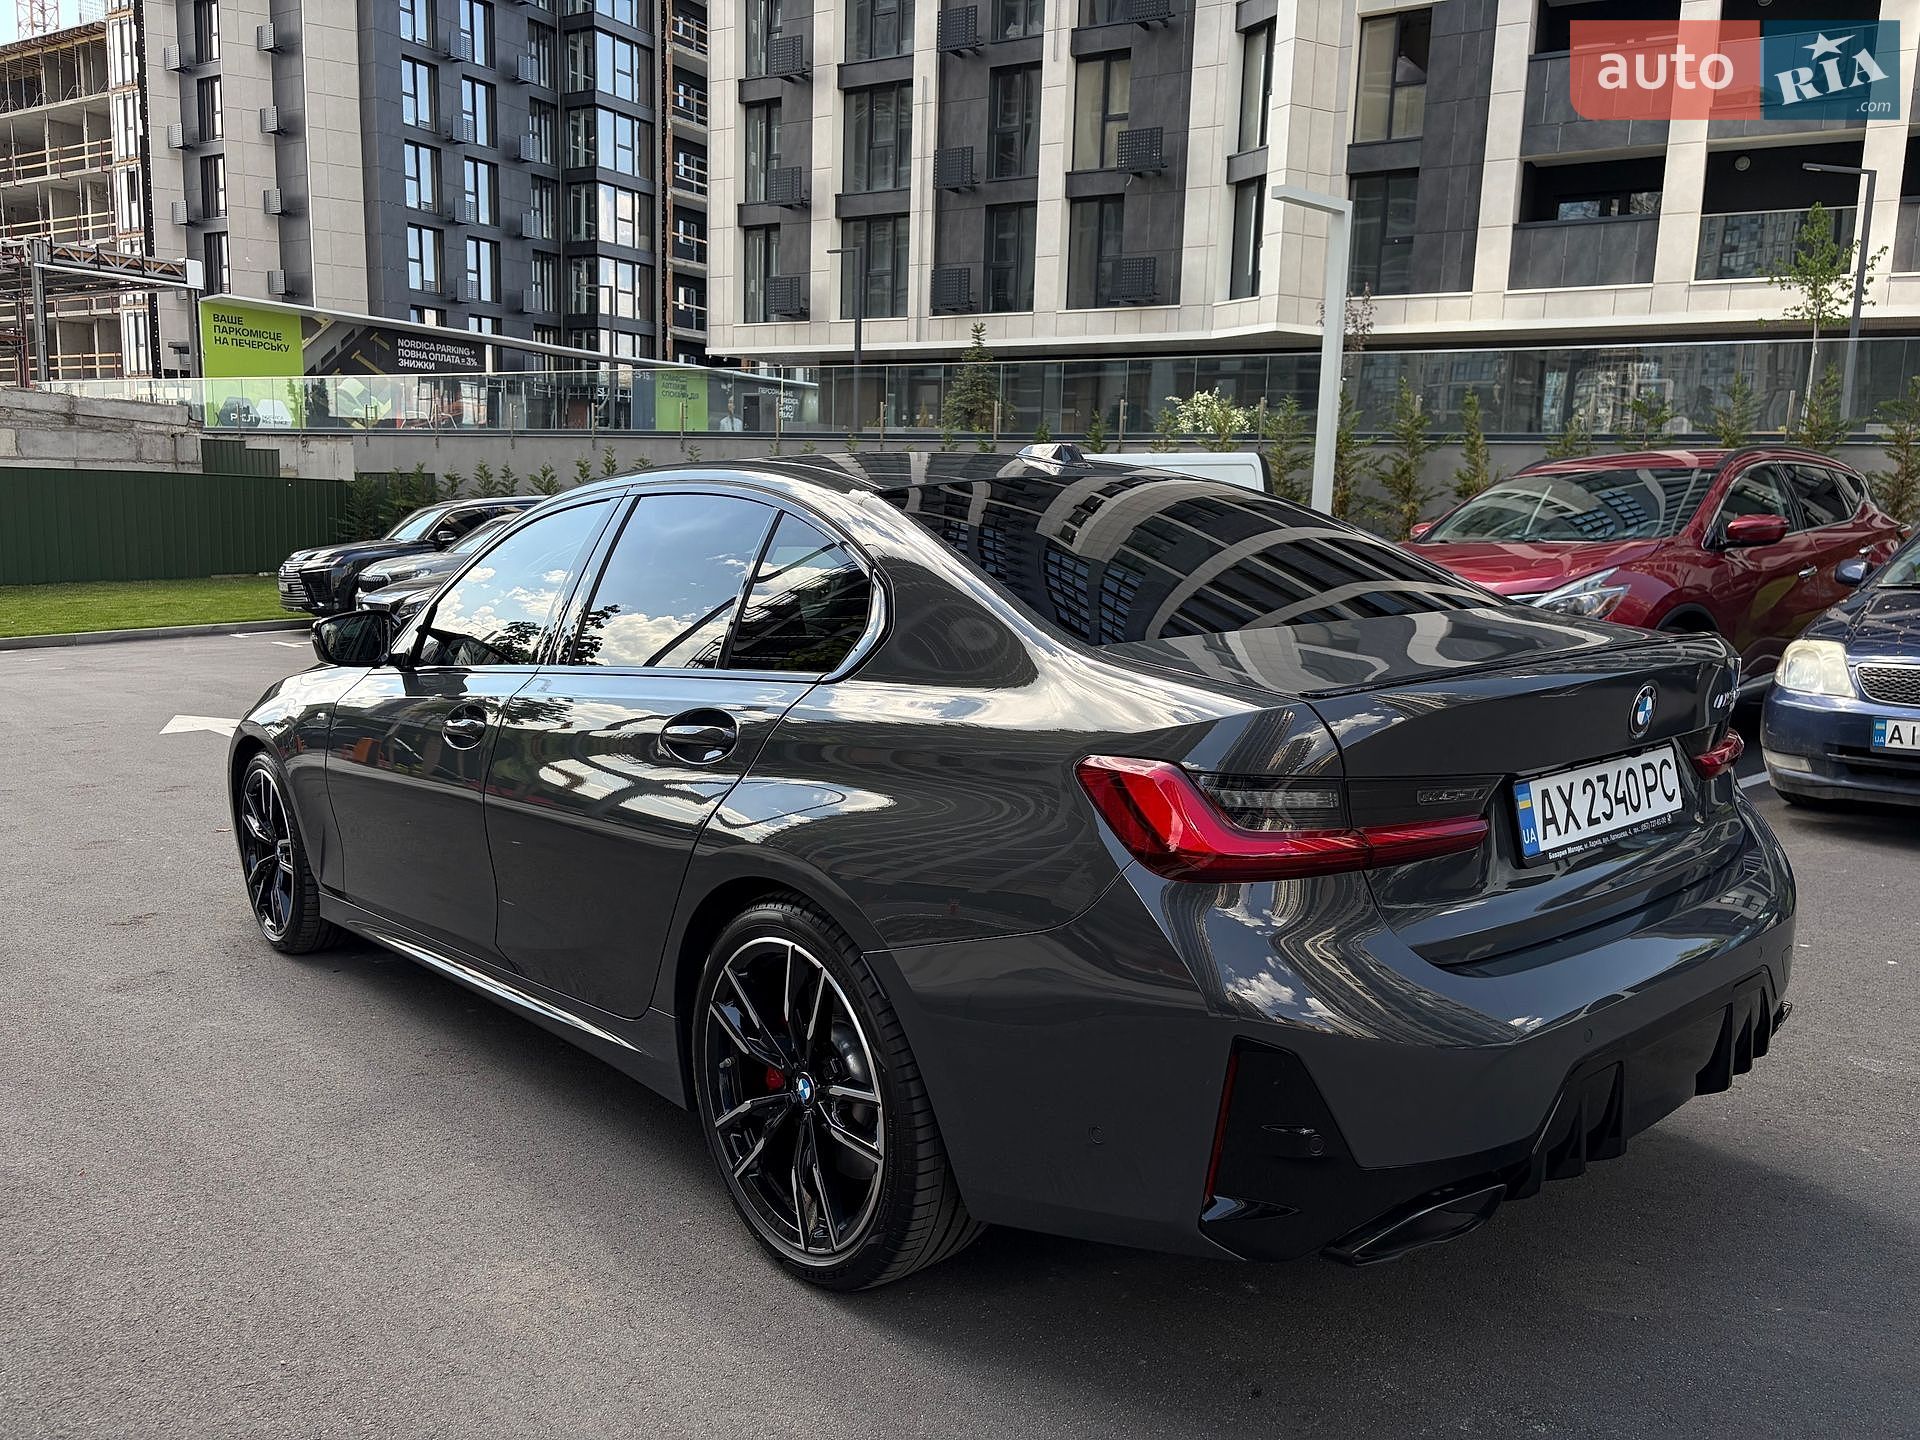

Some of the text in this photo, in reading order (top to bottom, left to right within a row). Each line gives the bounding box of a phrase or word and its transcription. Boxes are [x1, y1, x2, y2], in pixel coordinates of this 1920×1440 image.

[213, 313, 244, 326] ВАШЕ
[213, 324, 282, 342] ПАРКОМІСЦЕ
[214, 335, 290, 353] НА ПЕЧЕРСЬКУ
[397, 338, 436, 352] NORDICA
[436, 343, 471, 356] PARKING
[398, 348, 428, 361] ПОВНА
[428, 352, 461, 365] ОПЛАТА
[398, 358, 436, 371] ЗНИЖКИ
[1874, 735, 1885, 744] UA
[1540, 758, 1676, 841] AX 2340 PC
[1522, 828, 1537, 844] UA
